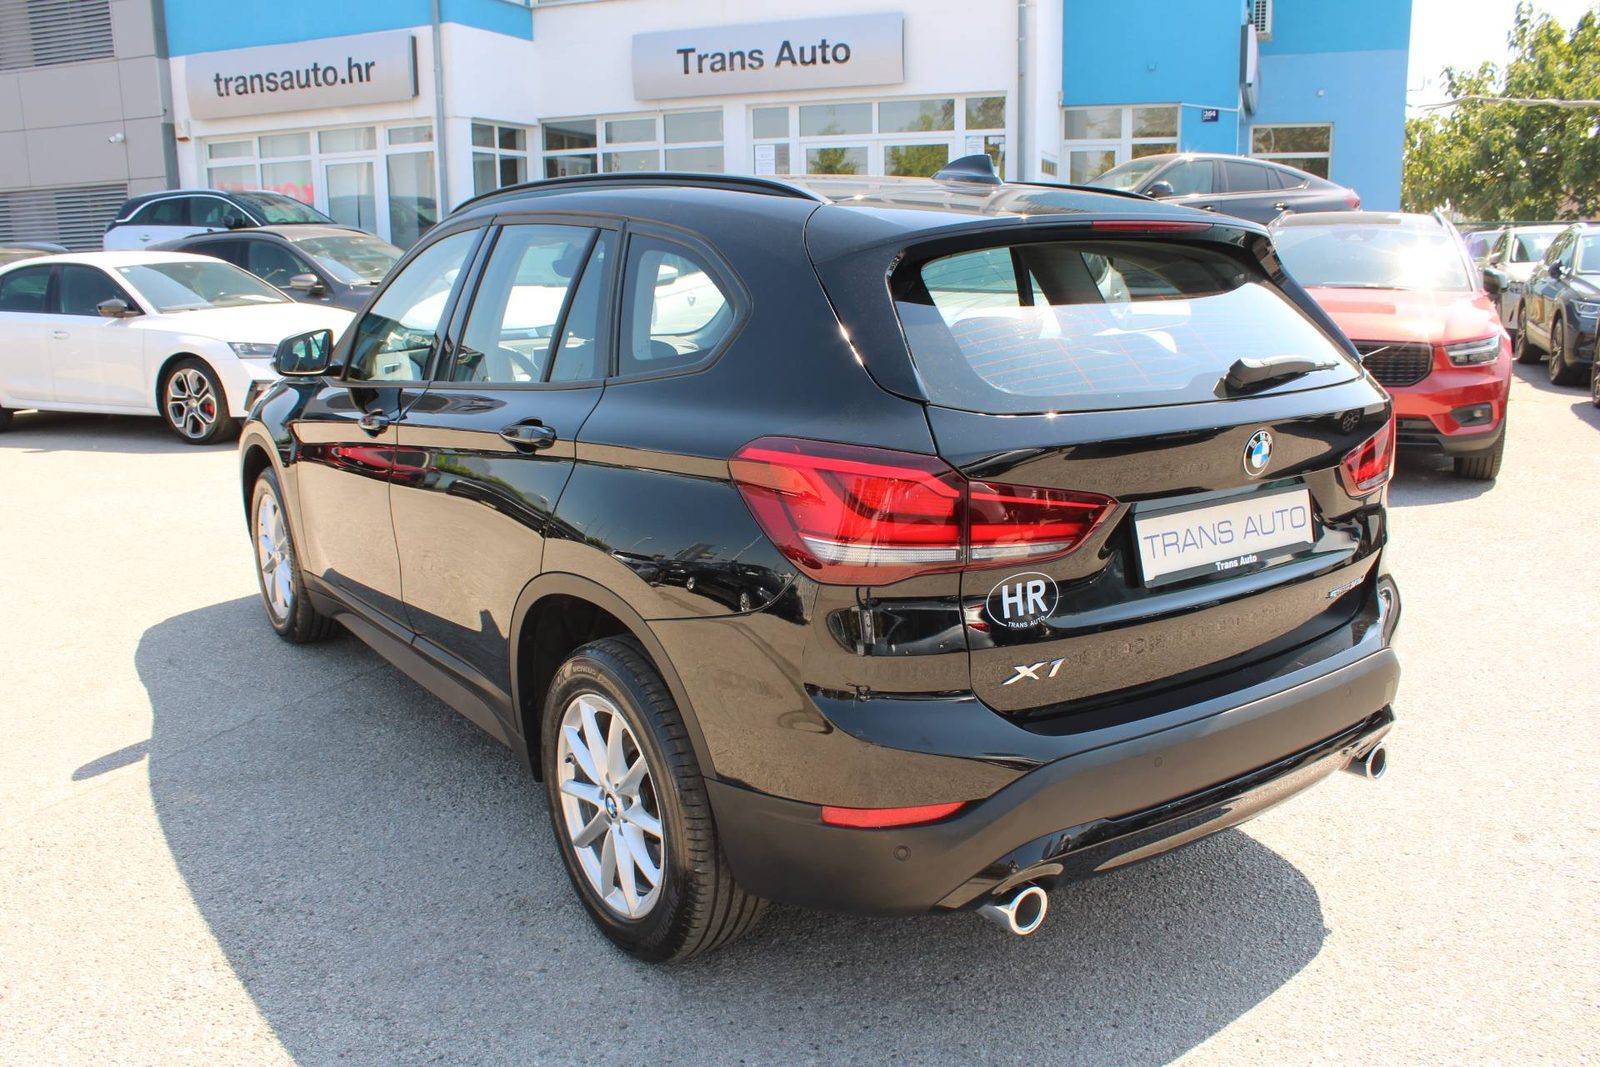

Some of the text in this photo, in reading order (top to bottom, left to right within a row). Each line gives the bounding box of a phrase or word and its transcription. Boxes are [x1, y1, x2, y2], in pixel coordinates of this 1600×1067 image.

[676, 38, 851, 75] Trans Auto
[213, 56, 375, 97] transauto.hr
[1143, 505, 1307, 559] TRANS AUTO
[1215, 554, 1258, 572] Trans Auto
[1002, 579, 1049, 619] HR
[1007, 614, 1046, 628] TRANS AUTO
[1001, 656, 1067, 685] X1
